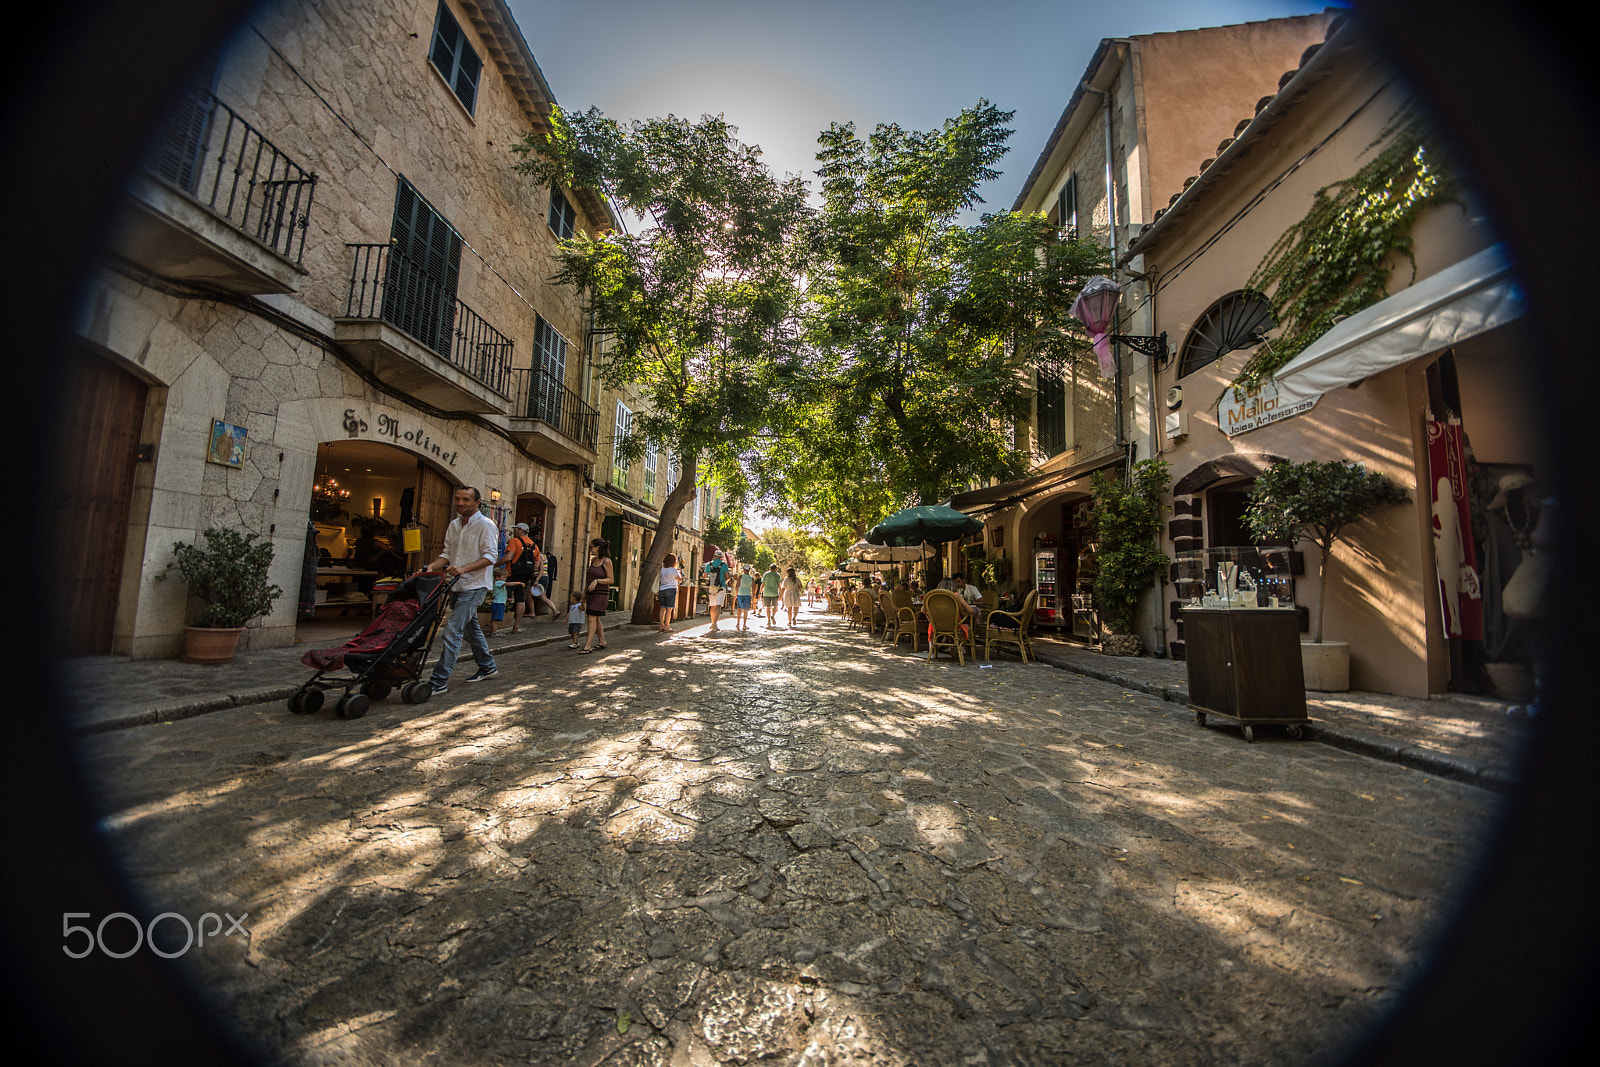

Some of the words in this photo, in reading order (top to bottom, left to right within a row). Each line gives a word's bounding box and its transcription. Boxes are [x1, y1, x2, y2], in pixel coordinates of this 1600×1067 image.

[343, 408, 368, 432] Es
[378, 413, 458, 467] Molinet
[1229, 422, 1254, 435] Joies
[1256, 400, 1313, 427] Artesanes
[1446, 425, 1460, 496] SALE
